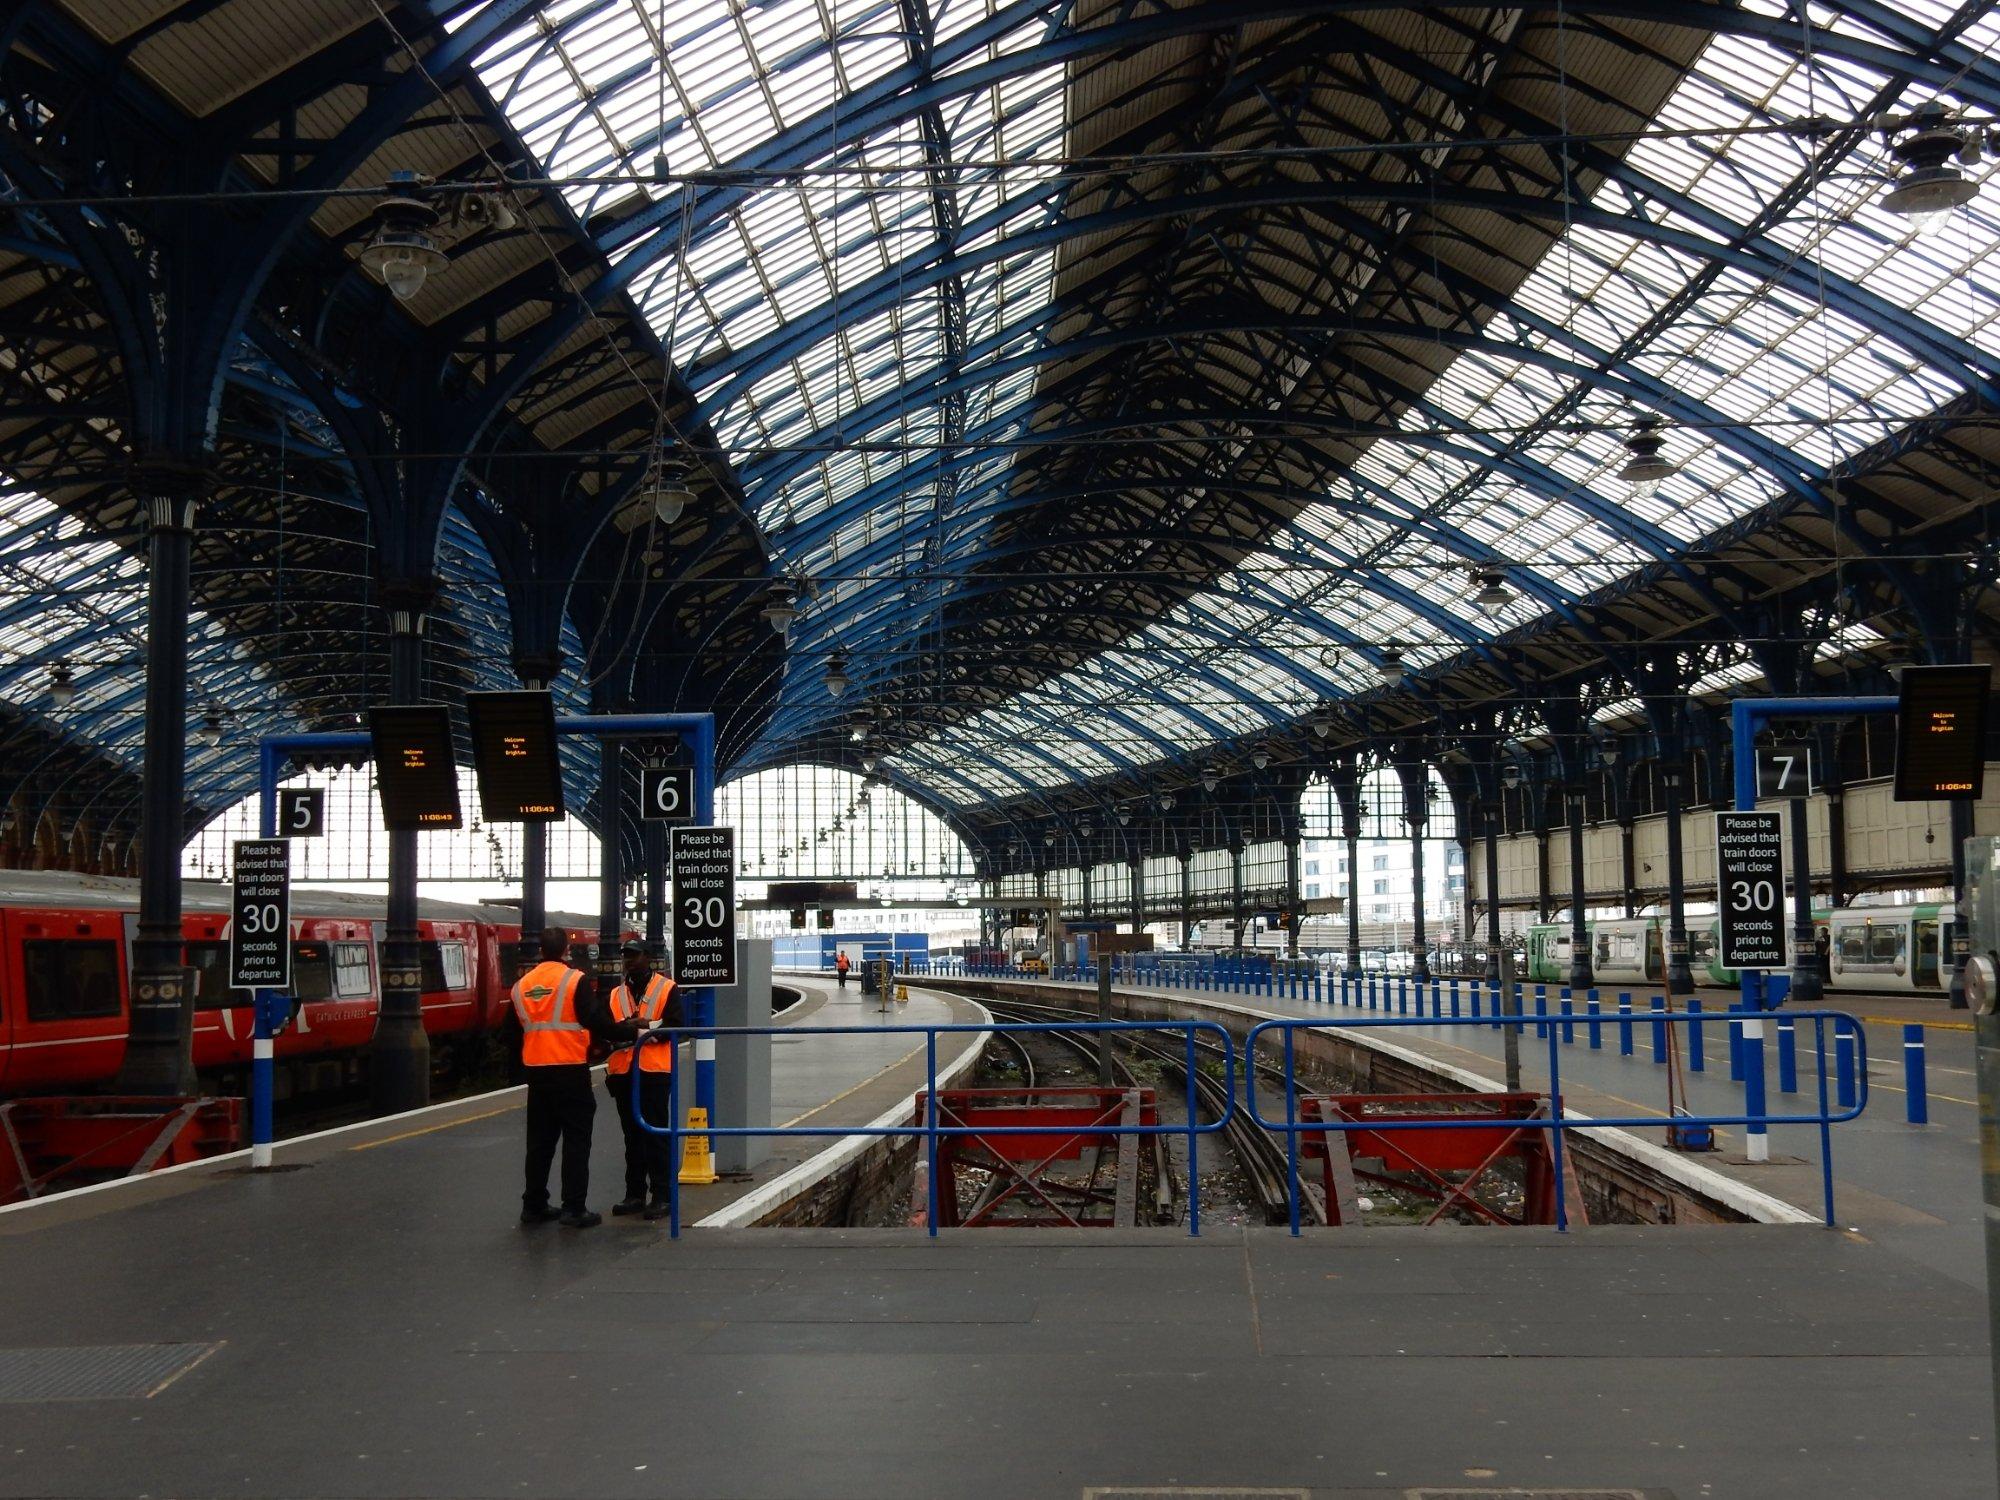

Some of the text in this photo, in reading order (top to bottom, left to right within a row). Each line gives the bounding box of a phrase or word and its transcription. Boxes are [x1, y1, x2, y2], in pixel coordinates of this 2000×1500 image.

[1772, 756, 1794, 790] 7
[657, 776, 679, 811] 6
[293, 796, 311, 829] 5
[1725, 818, 1772, 829] Please be
[680, 833, 725, 844] Please be
[1720, 833, 1780, 843] advised that
[241, 845, 281, 855] Please be
[674, 848, 732, 860] advised that
[1724, 847, 1777, 858] train doors
[235, 859, 287, 870] advised that
[678, 863, 729, 874] train doors
[1727, 862, 1773, 872] will close
[238, 873, 285, 883] train doors
[681, 878, 725, 889] will close
[241, 887, 280, 896] will close
[1731, 880, 1775, 912] 30
[242, 903, 280, 934] 30
[684, 897, 725, 929] 30
[1732, 920, 1773, 930] seconds
[242, 941, 277, 951] seconds
[685, 937, 723, 948] seconds
[1735, 935, 1772, 947] prior to
[243, 955, 276, 967] prior to
[687, 952, 722, 965] prior to
[1730, 950, 1779, 962] departure
[238, 969, 281, 981] departure
[681, 967, 728, 980] departure
[316, 1008, 368, 1023] GATWICK EXPRESS
